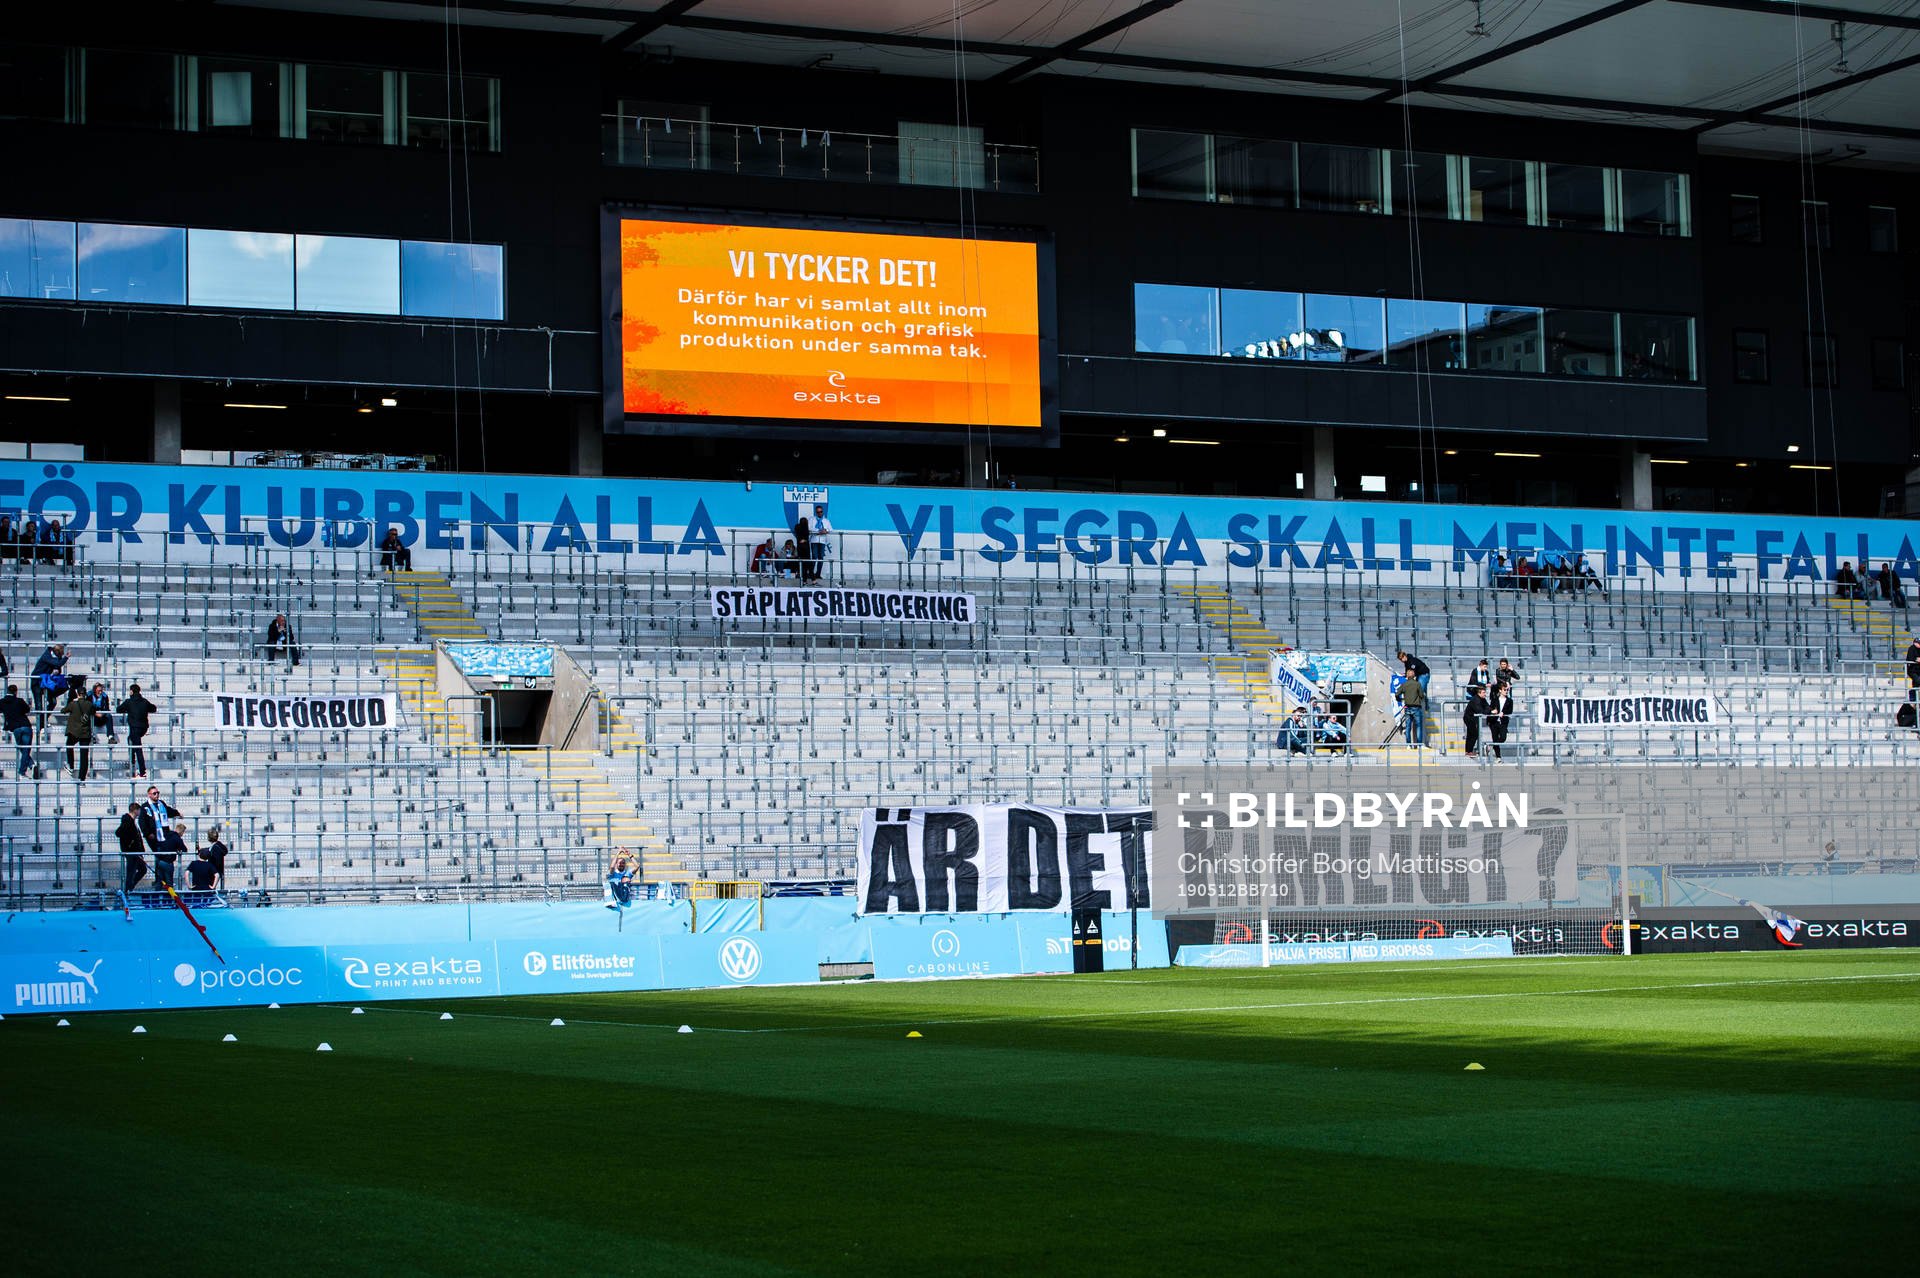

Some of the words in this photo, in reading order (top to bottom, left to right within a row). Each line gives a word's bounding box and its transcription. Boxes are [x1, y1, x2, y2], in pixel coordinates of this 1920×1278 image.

[728, 250, 755, 279] VI
[764, 252, 870, 285] TYCKER
[879, 258, 937, 288] DET!
[677, 288, 747, 307] Därför
[754, 292, 790, 308] har
[796, 295, 814, 309] vi
[821, 297, 891, 313] samlat
[898, 300, 932, 315] allt
[938, 302, 987, 318] inom
[693, 310, 854, 332] kommunikation
[861, 320, 896, 335] och
[903, 321, 975, 338] grafisk
[679, 332, 794, 351] produktion
[801, 337, 862, 353] under
[869, 342, 942, 357] samma
[950, 343, 988, 359] tak.
[793, 389, 881, 405] exakta
[168, 483, 519, 551] KLUBBEN
[542, 493, 727, 557] ALLA
[886, 503, 955, 561] VI
[979, 506, 1208, 567] SEGRA
[1228, 512, 1431, 572] SKALL
[1605, 524, 1737, 578] INTE
[715, 588, 970, 622] STÅPLATSREDUCERING
[216, 695, 387, 729] TIFOFÖRBUD
[1543, 697, 1708, 725] INTIMVISITERING
[864, 808, 979, 912] ÄR
[1008, 807, 1155, 911] DET
[1641, 920, 1740, 942] exakta
[1808, 918, 1909, 938] exakta
[551, 953, 636, 971] Elitfönster
[1269, 947, 1305, 961] HALVA
[1308, 945, 1348, 960] PRISET
[1350, 944, 1378, 958] MED
[1381, 942, 1434, 957] BROPASS
[200, 963, 302, 994] prodoc
[374, 955, 482, 977] exakta
[907, 961, 990, 974] CABONLINE
[15, 981, 86, 1007] PUMA
[375, 979, 408, 988] PRINT
[412, 978, 434, 987] AND
[439, 976, 482, 985] BEYOND
